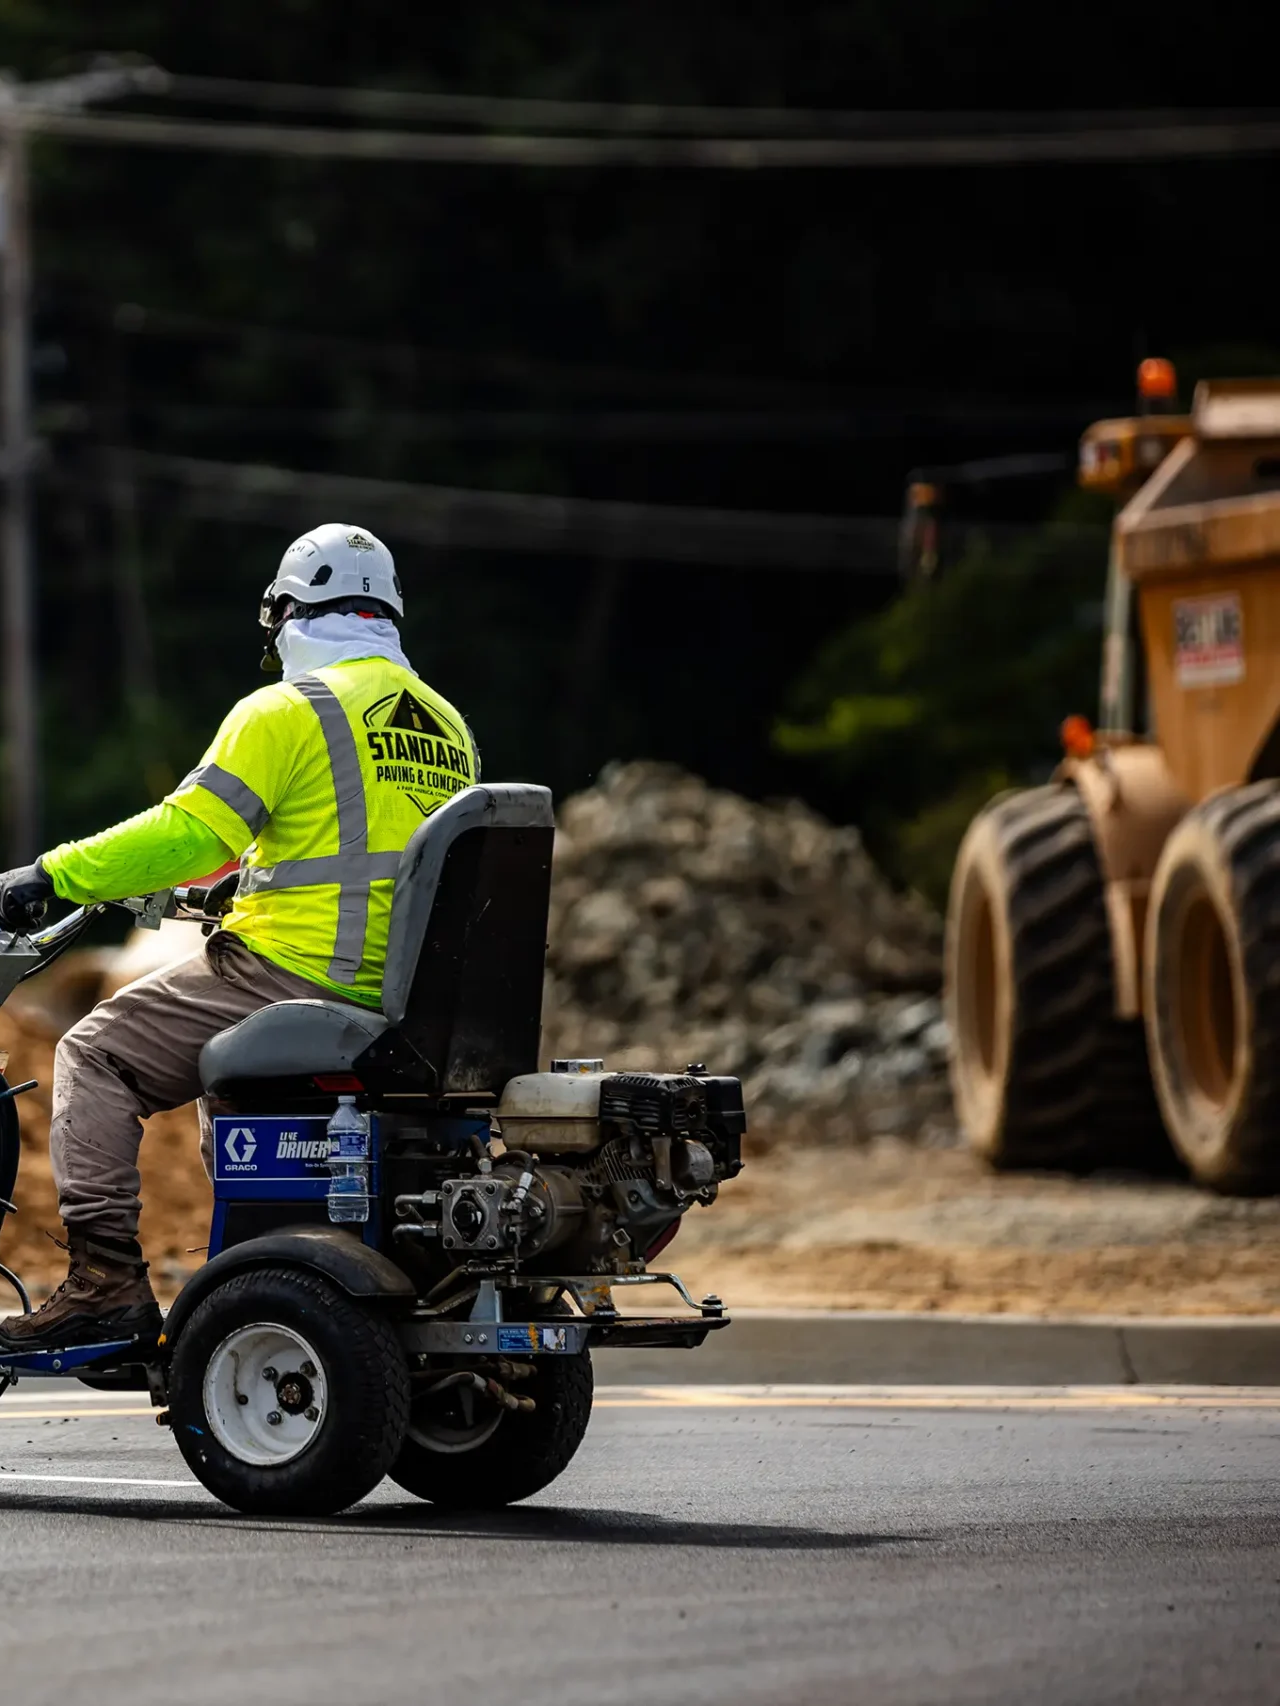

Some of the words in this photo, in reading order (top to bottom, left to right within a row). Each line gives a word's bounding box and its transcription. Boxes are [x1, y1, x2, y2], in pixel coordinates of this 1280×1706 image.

[363, 577, 370, 592] 5
[367, 732, 470, 779] STANDARD
[377, 766, 415, 783] PAVING
[417, 769, 425, 786] &
[276, 1141, 328, 1159] DRIVER
